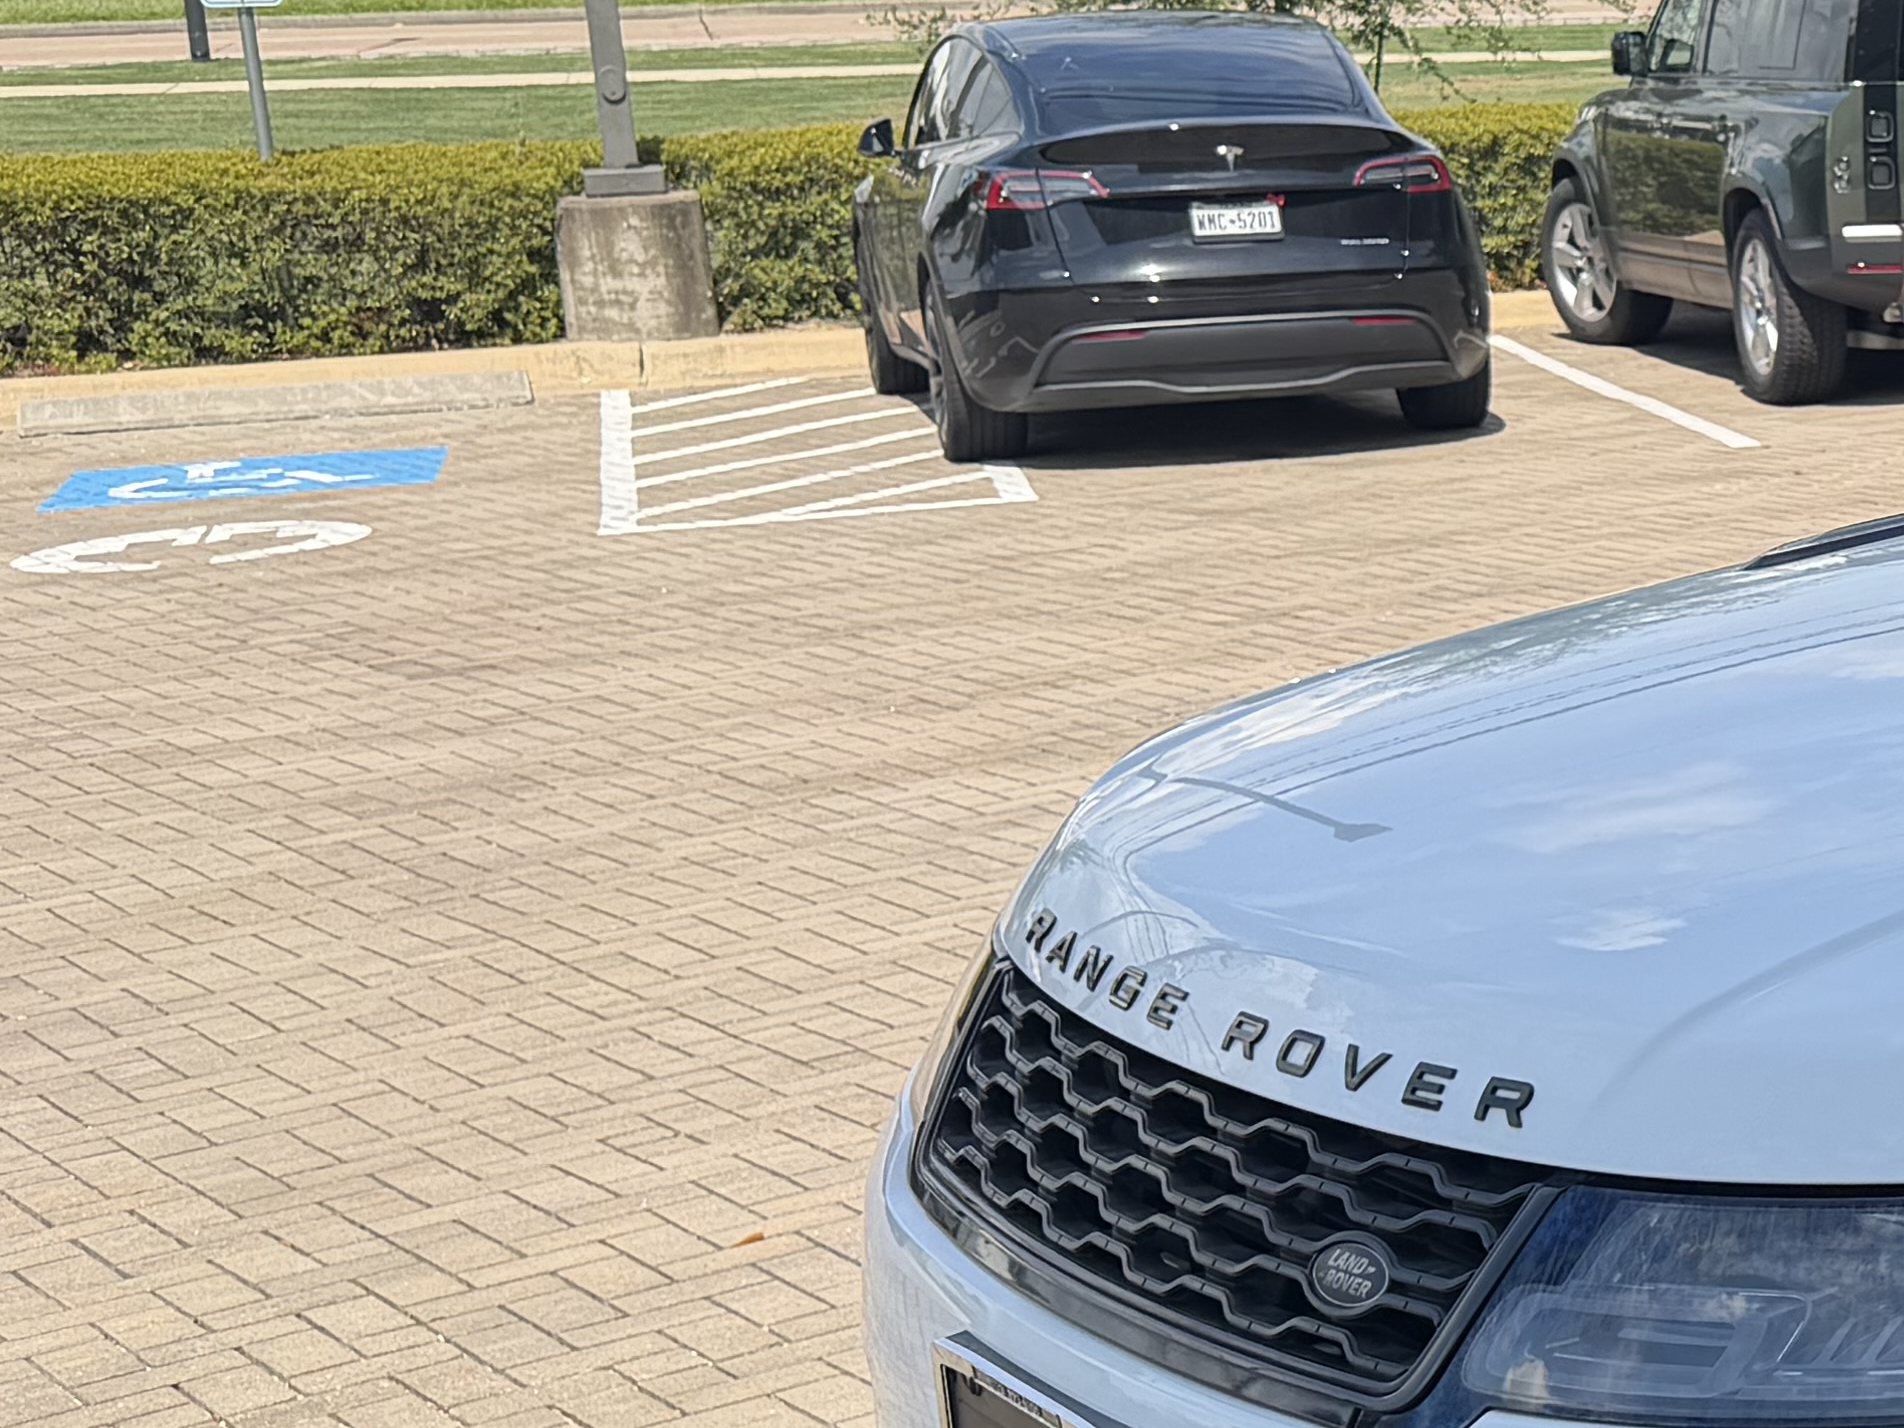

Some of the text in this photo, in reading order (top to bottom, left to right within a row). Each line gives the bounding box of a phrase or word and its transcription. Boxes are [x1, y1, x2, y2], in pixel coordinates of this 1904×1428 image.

[1026, 908, 1535, 1129] RANGE ROVER
[1327, 1248, 1370, 1275] LAND
[1323, 1268, 1373, 1299] ROVER
